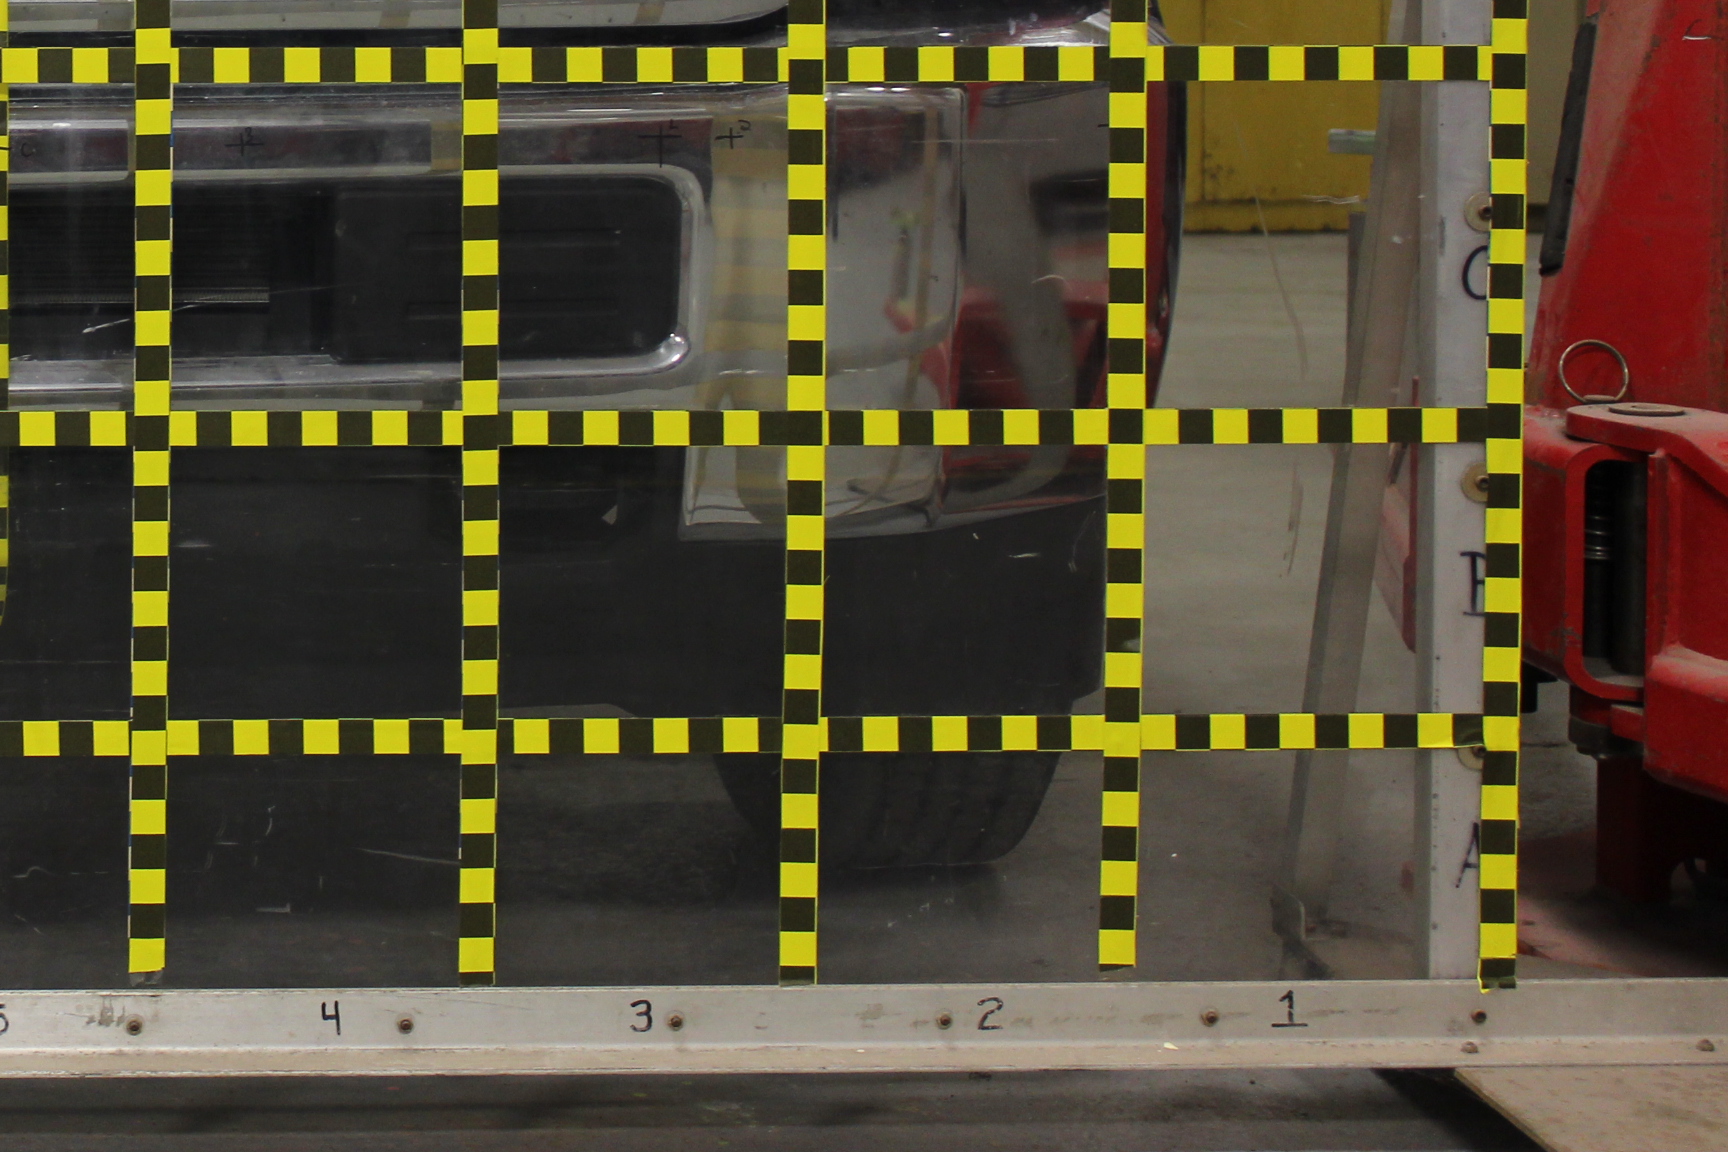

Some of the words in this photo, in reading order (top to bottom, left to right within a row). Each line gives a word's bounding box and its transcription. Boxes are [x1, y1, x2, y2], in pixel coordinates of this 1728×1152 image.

[321, 1000, 341, 1037] 4
[629, 999, 653, 1033] 3
[976, 996, 1004, 1031] 2
[1272, 989, 1308, 1028] 1
